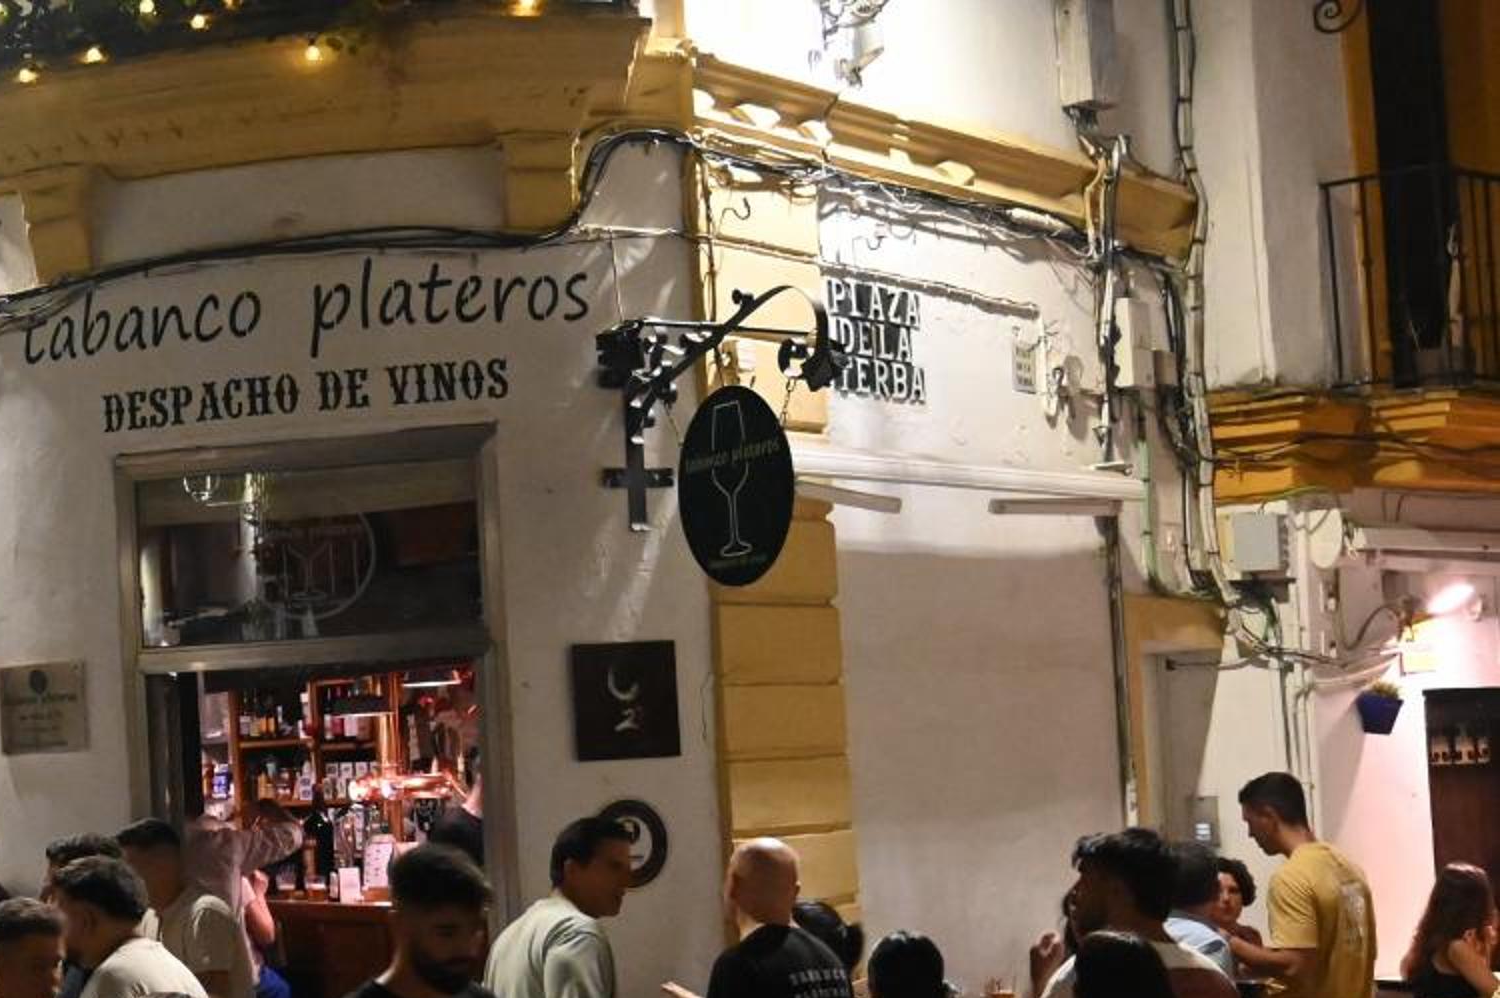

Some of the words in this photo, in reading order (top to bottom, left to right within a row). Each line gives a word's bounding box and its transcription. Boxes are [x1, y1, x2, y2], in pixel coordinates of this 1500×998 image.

[21, 287, 262, 365] tabanco
[310, 256, 589, 359] plateros
[829, 279, 921, 329] PLAZA
[103, 373, 299, 433] DESPACHO
[315, 368, 370, 412] DE
[385, 357, 509, 405] VINOS
